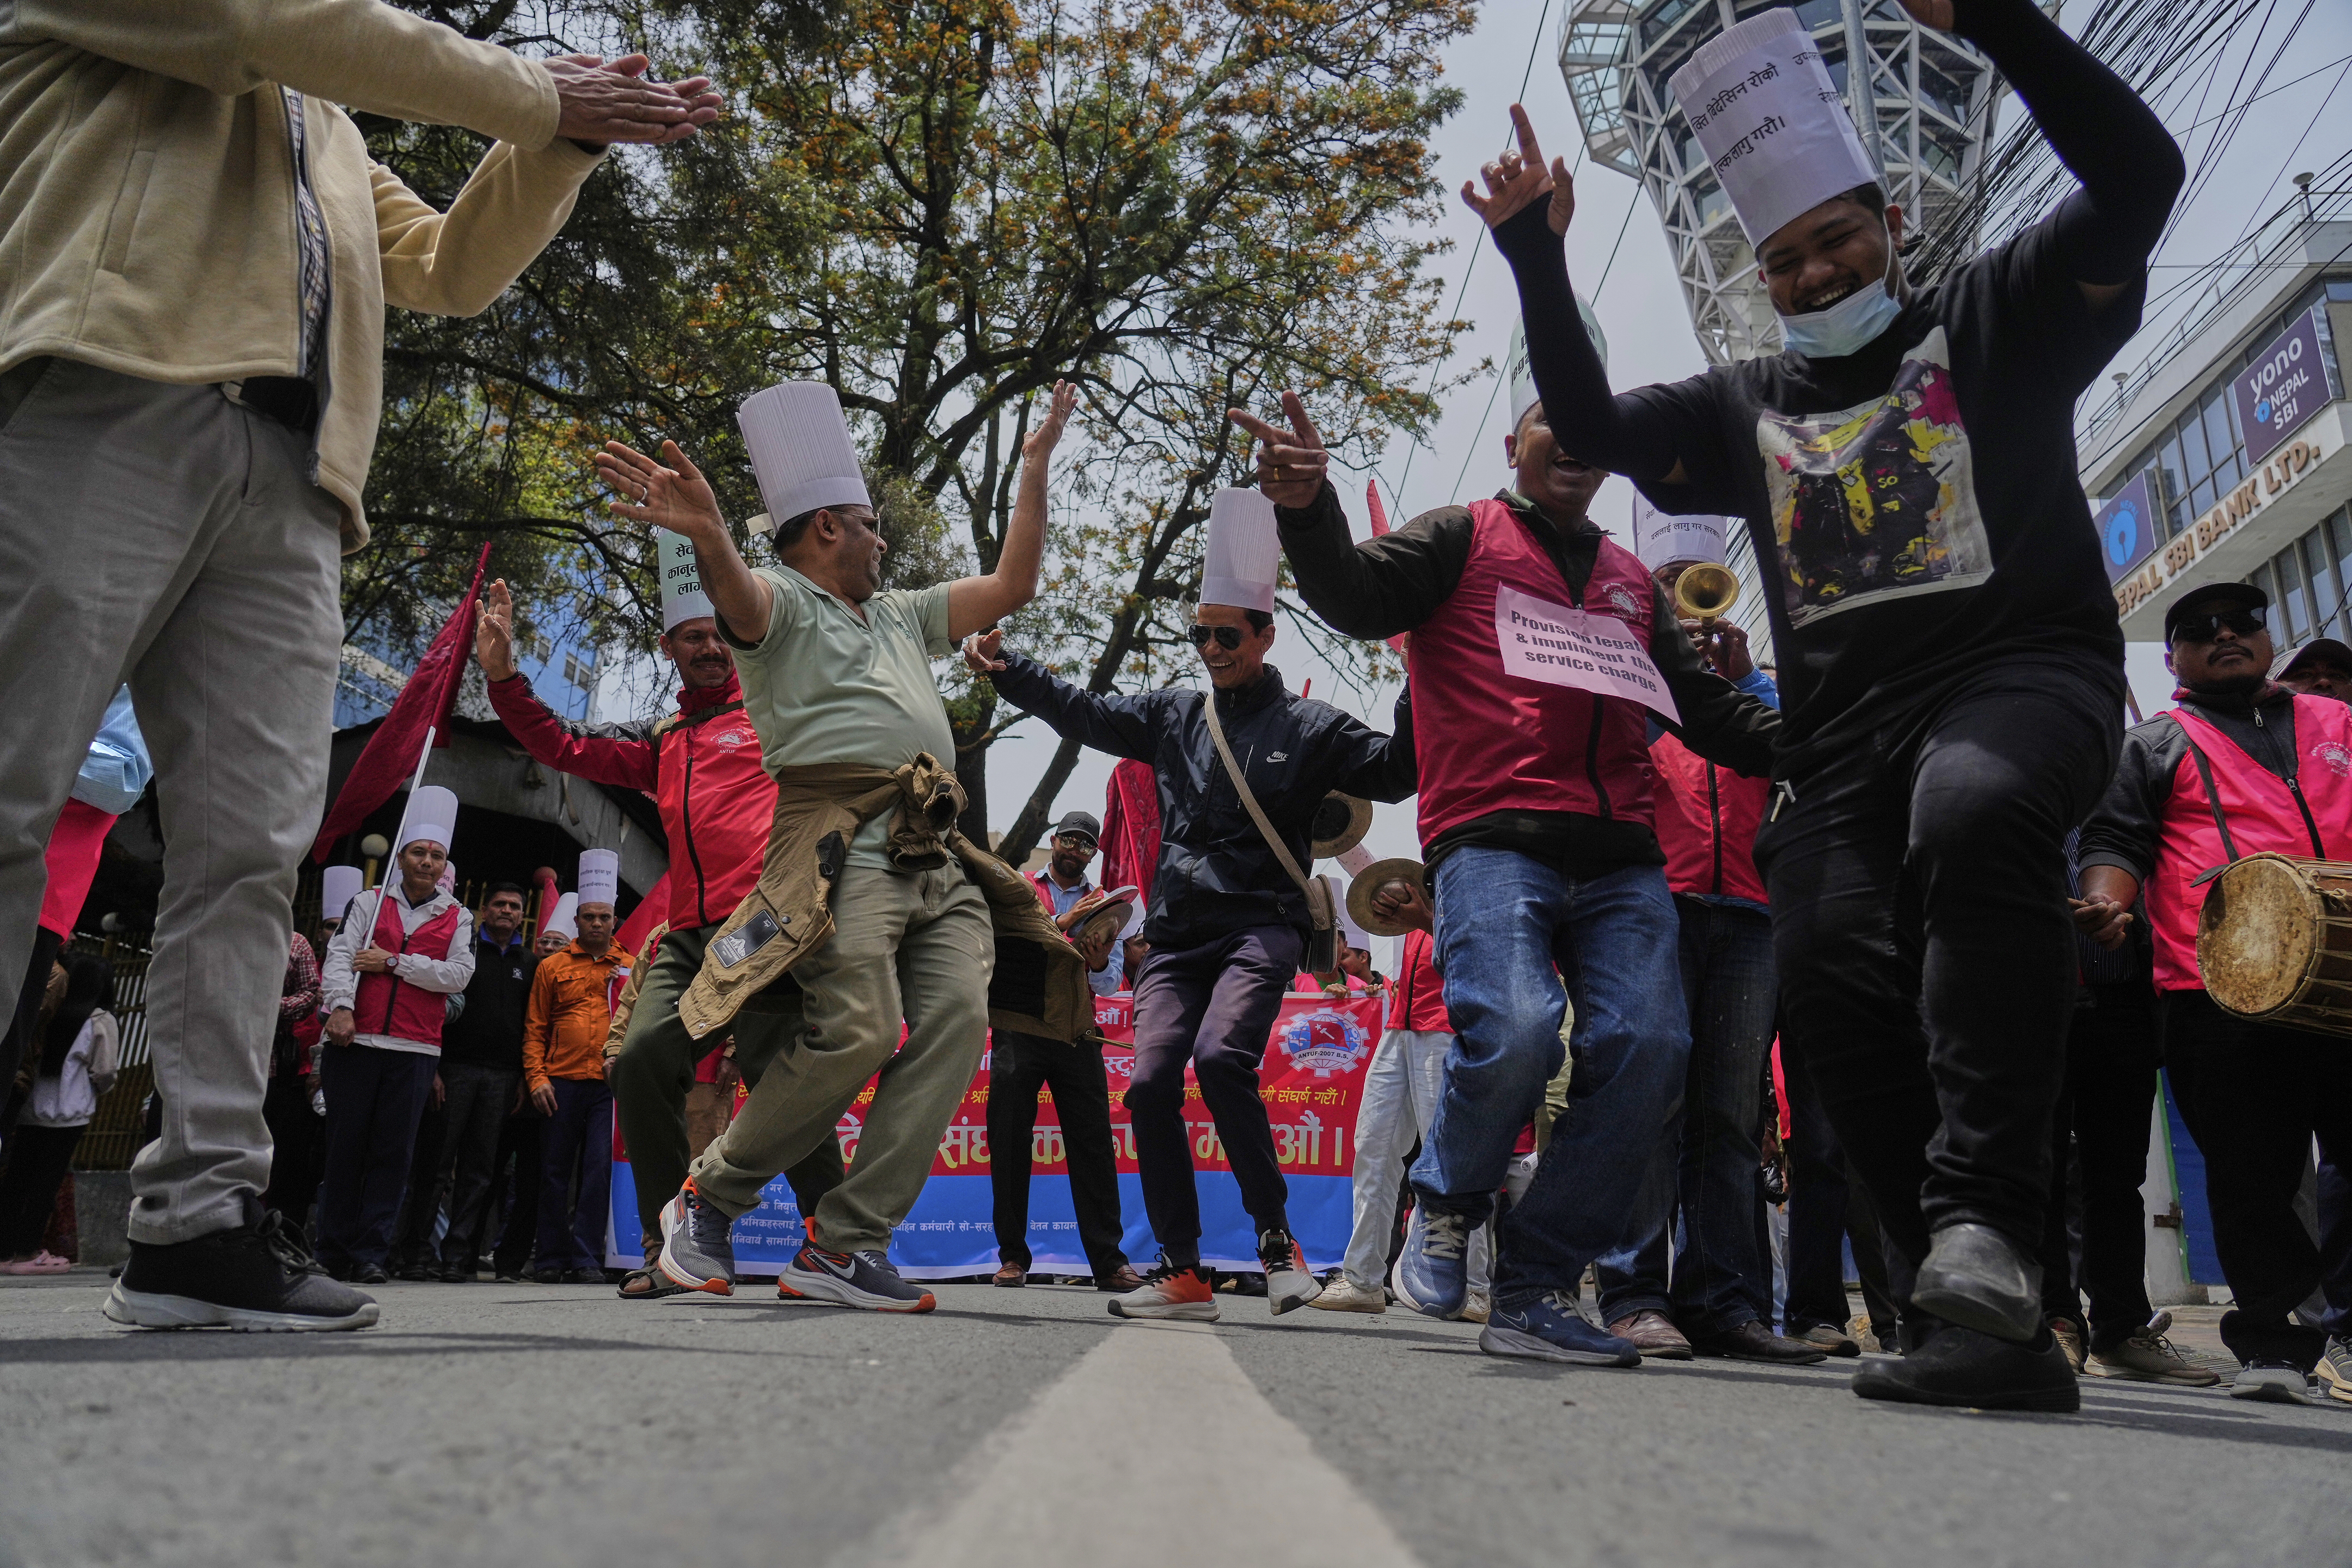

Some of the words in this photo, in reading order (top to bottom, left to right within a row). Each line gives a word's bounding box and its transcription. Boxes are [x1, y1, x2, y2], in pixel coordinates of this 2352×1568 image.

[2250, 338, 2302, 404] yono
[2270, 367, 2309, 410] NEPAL
[2274, 397, 2298, 430] SBI
[1651, 523, 1671, 540] यसलाई
[2115, 564, 2162, 616] EPAL
[2164, 534, 2195, 576] SBI
[2196, 479, 2261, 550] BANK
[2263, 441, 2320, 494] LTD.
[1511, 610, 1592, 644] Provision
[1516, 633, 1528, 644] &
[1532, 635, 1625, 664] impliment
[1631, 656, 1656, 676] the
[1525, 652, 1594, 671] service
[1598, 665, 1657, 693] charge
[1272, 751, 1289, 759] NIKE
[1278, 1086, 1311, 1103] संघर्ष
[920, 1220, 954, 1233] कर्मचारी
[814, 1261, 829, 1273] FASHION
